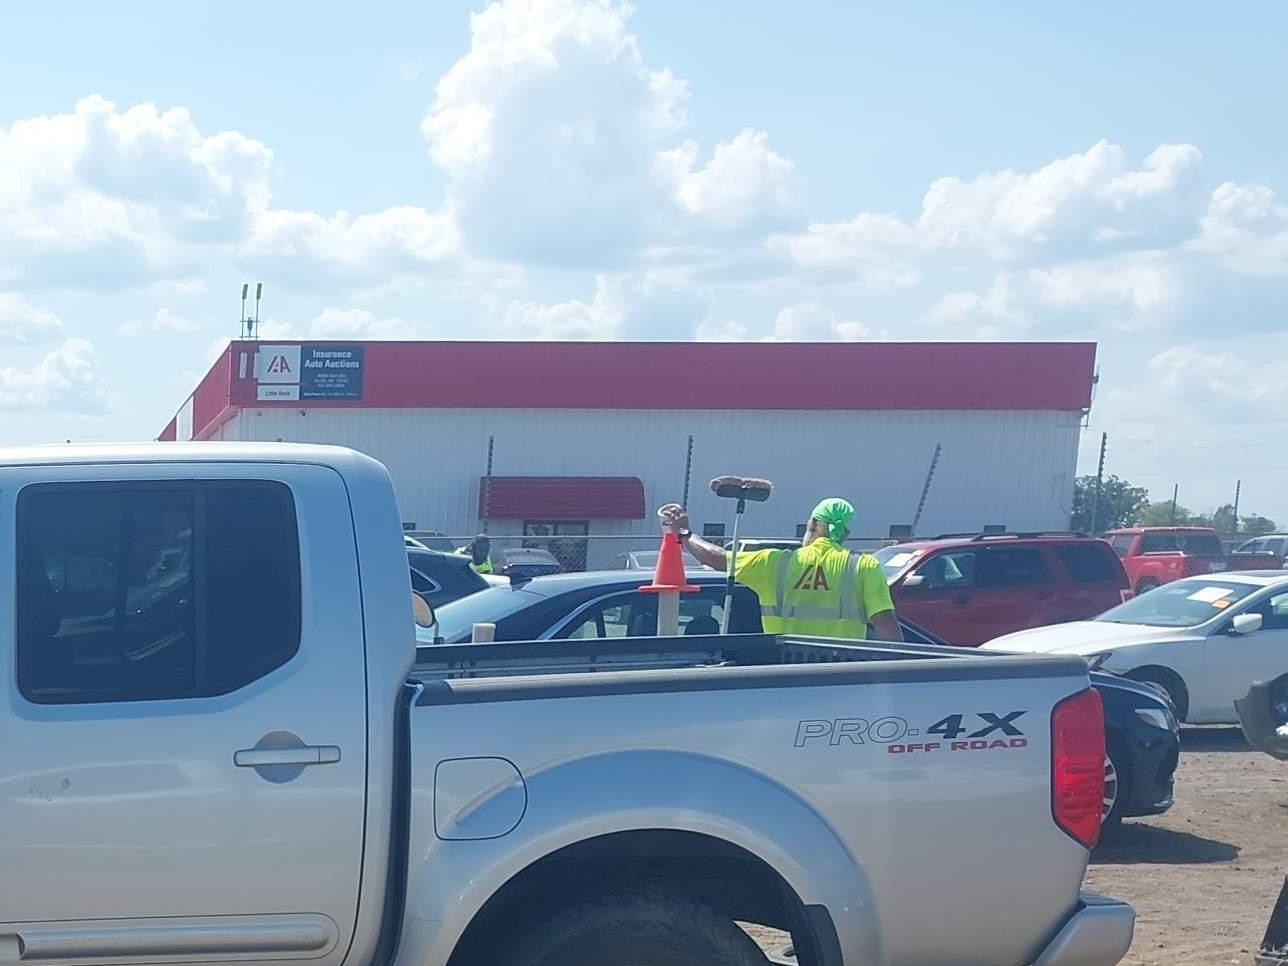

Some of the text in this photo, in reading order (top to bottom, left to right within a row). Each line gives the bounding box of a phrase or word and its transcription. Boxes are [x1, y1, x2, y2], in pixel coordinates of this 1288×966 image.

[312, 350, 352, 359] Insurance
[304, 359, 360, 368] Auto Auctions
[887, 738, 1028, 754] OFF ROAD
